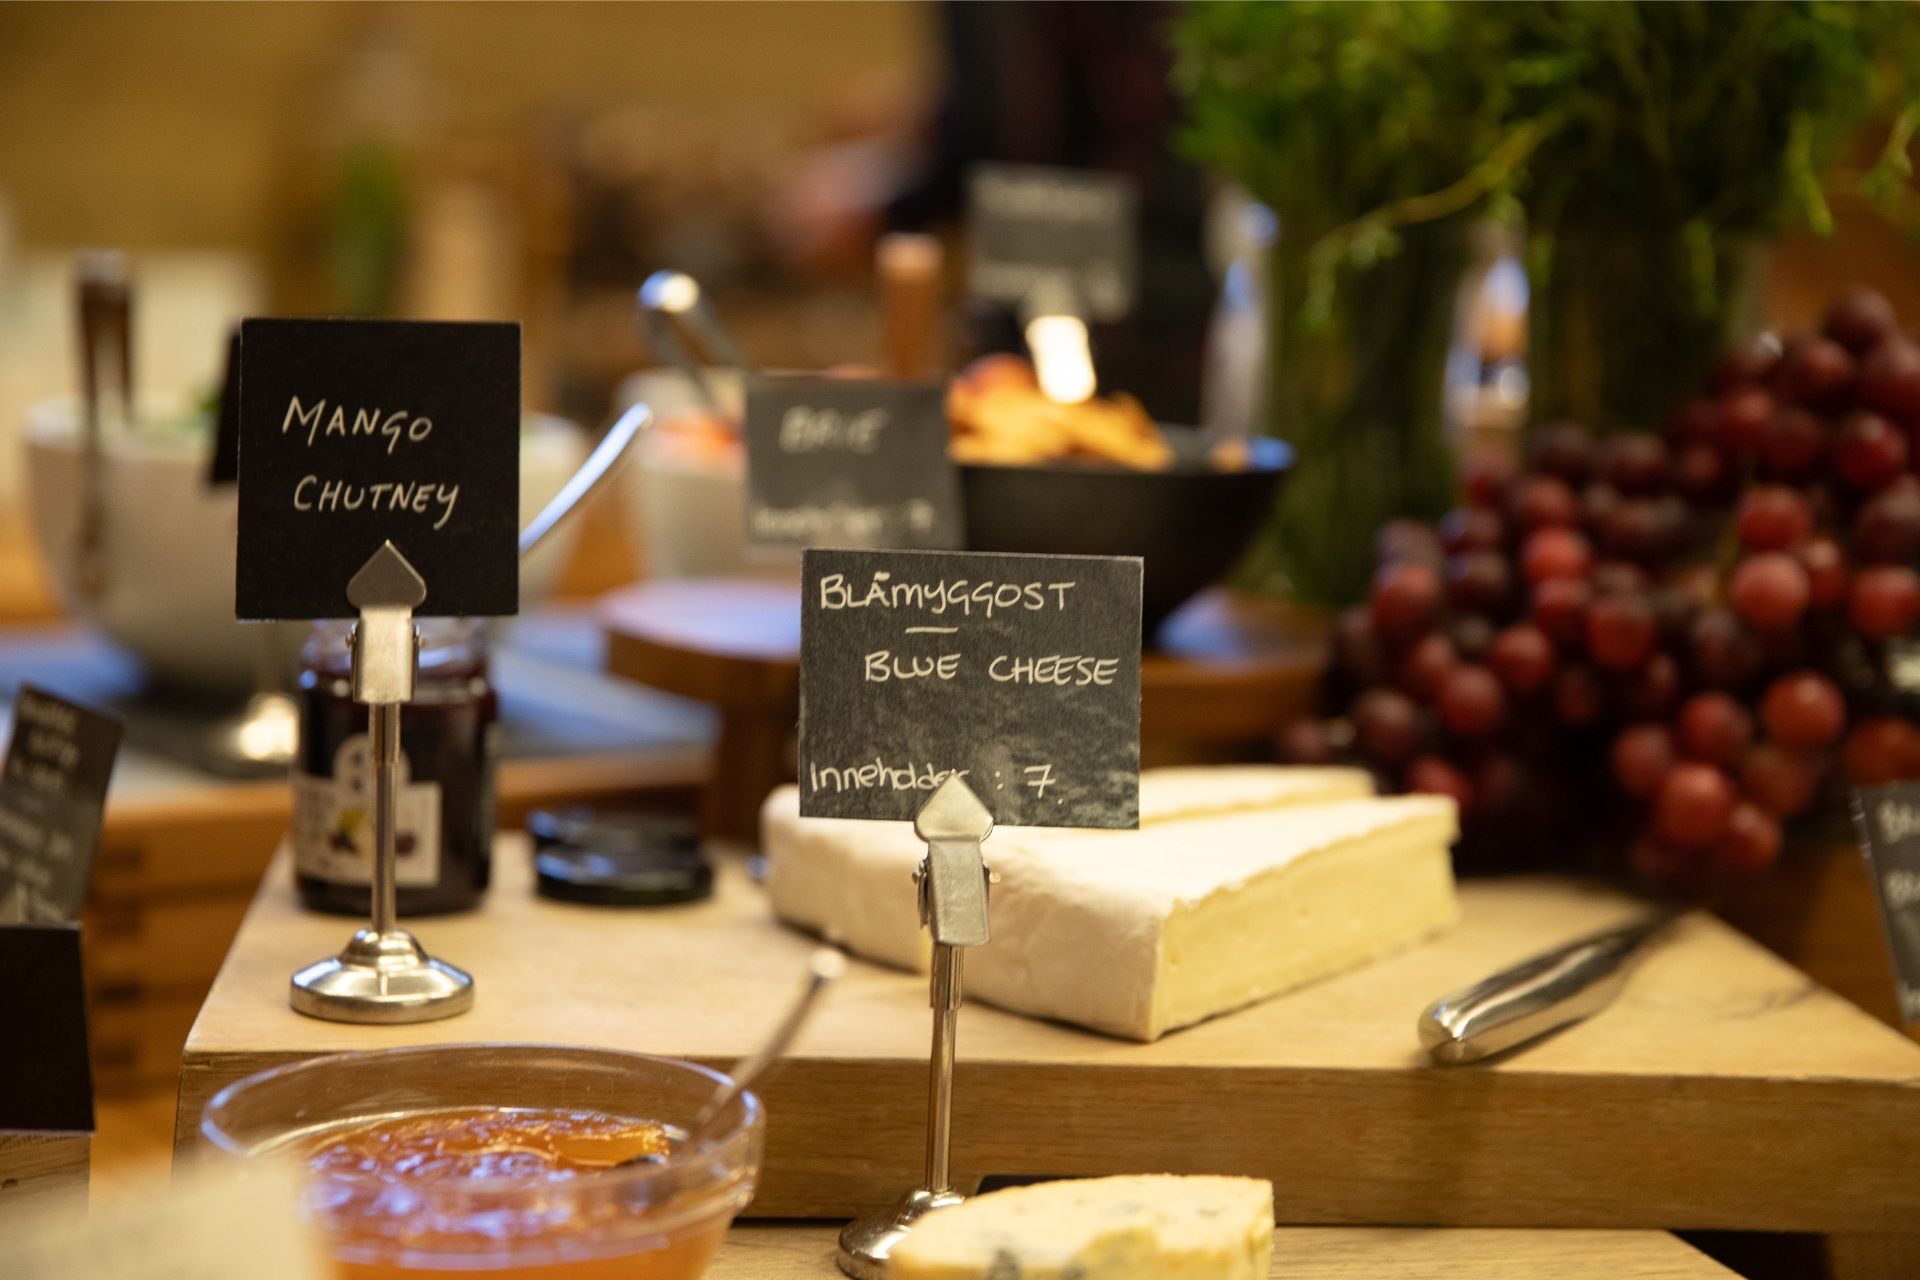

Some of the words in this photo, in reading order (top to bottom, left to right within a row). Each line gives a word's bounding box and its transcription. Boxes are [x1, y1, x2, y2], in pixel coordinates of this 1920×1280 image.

[282, 395, 433, 455] MANGO
[293, 474, 460, 531] CHUTNEY
[865, 650, 961, 683] BLUE
[988, 655, 1120, 686] CHEESE
